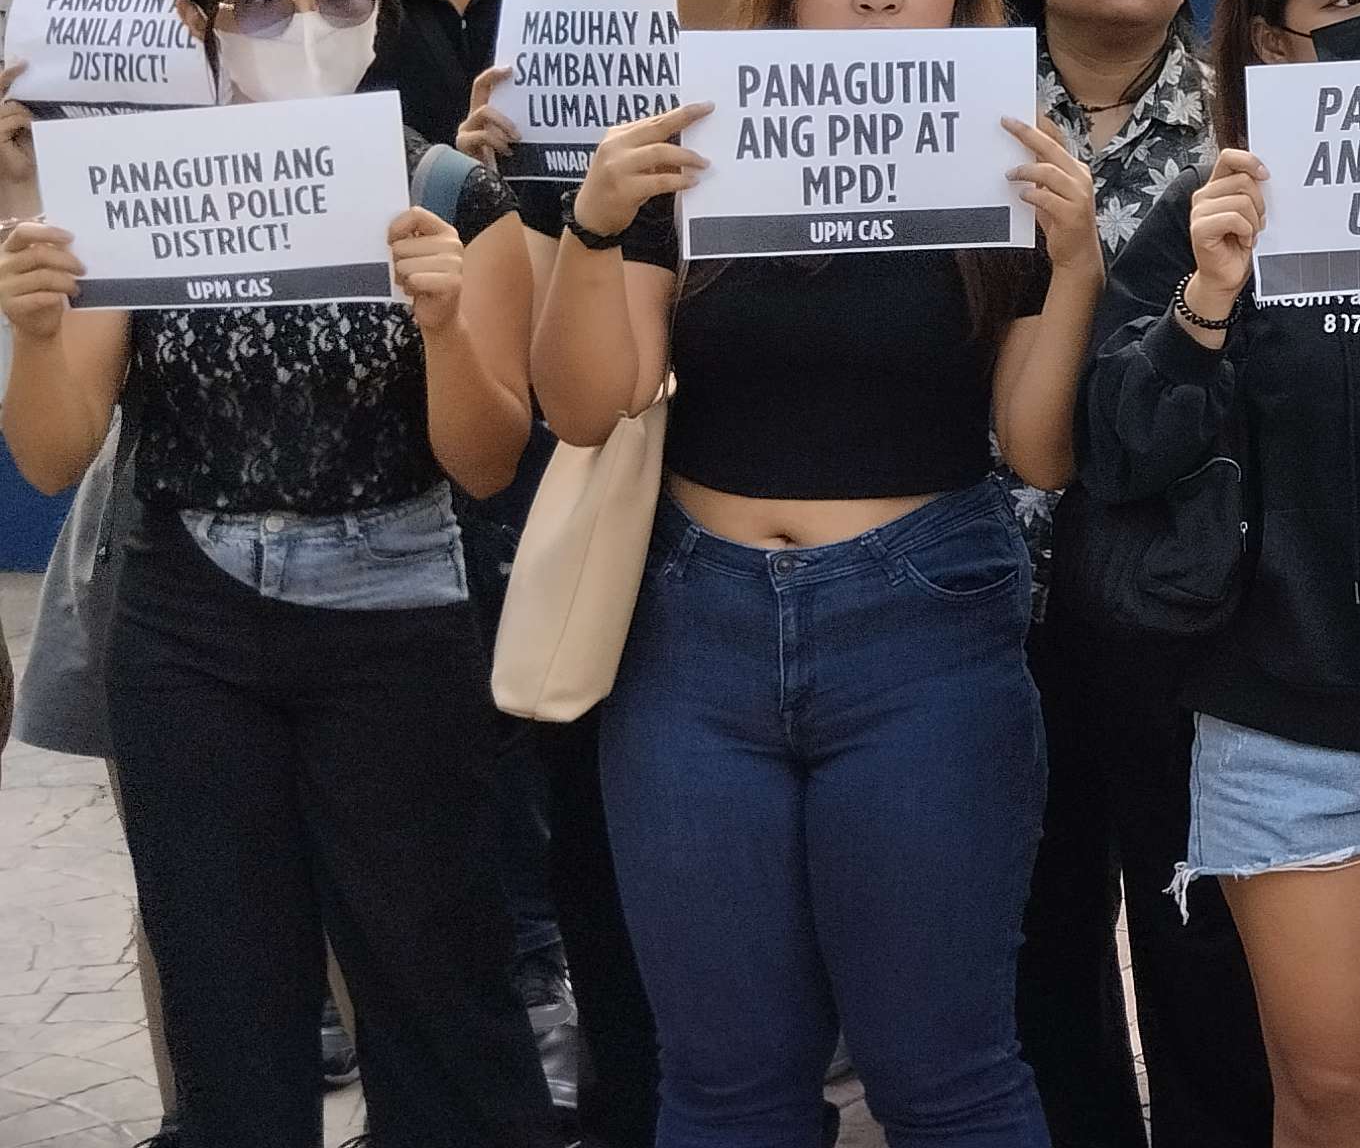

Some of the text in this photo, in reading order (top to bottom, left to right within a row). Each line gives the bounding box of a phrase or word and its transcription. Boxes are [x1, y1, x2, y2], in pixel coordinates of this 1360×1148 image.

[46, 17, 122, 47] MANILA
[522, 11, 639, 45] MABUHAY
[69, 52, 169, 83] DISTRICT!
[514, 52, 680, 86] SAMBAYANA
[737, 60, 956, 108] PANAGUTIN
[529, 93, 680, 127] LUMALABA
[736, 111, 959, 160] ANG PNP AT
[89, 146, 334, 195] PANAGUTIN ANG
[545, 150, 594, 171] NNAR
[803, 163, 898, 207] MPD!
[106, 185, 327, 229] MANILA POLICE
[152, 222, 291, 260] DISTRICT!
[809, 219, 894, 244] UPM CAS
[187, 277, 273, 300] UPM CAS
